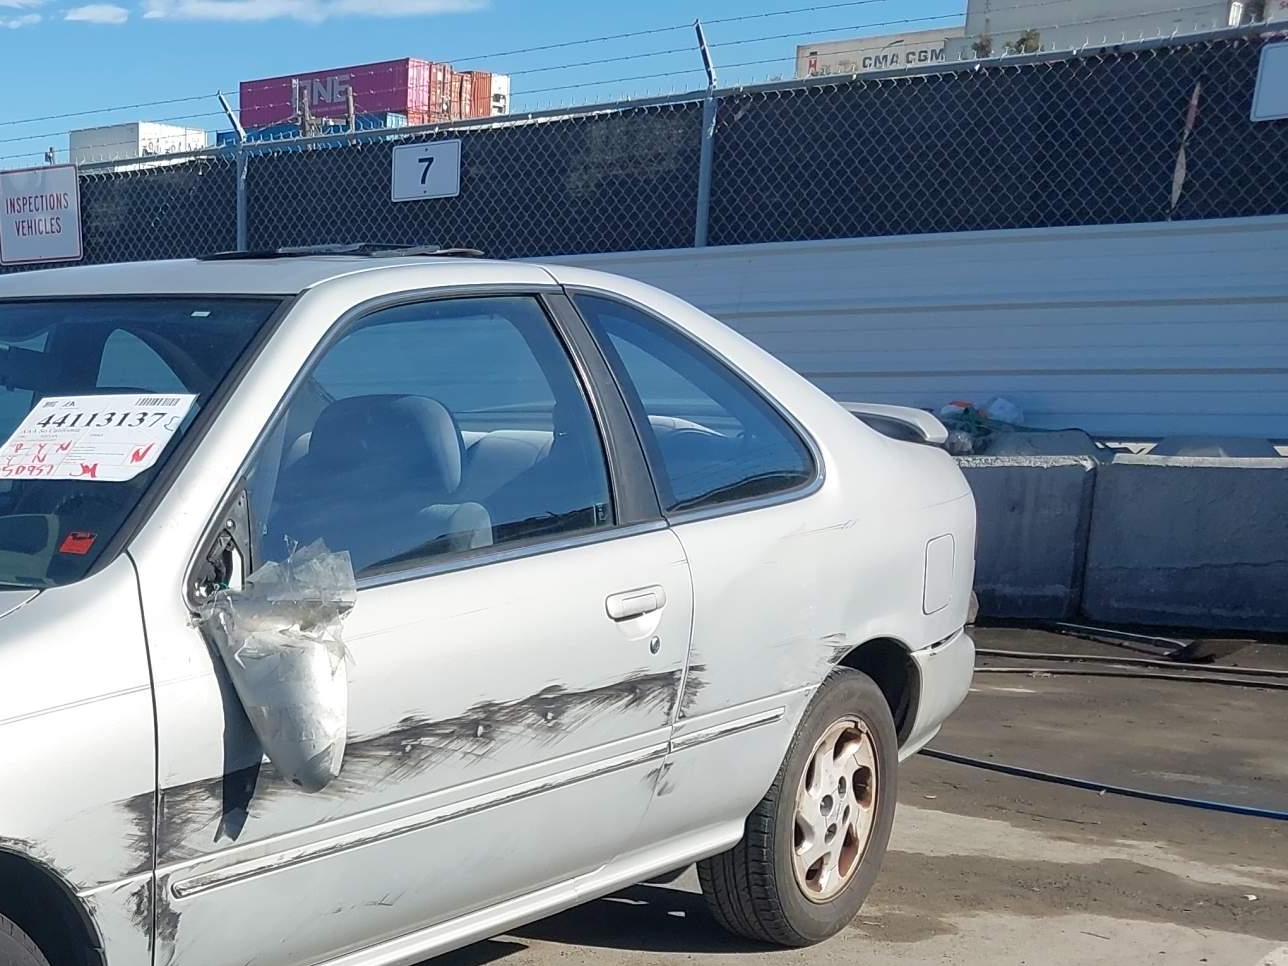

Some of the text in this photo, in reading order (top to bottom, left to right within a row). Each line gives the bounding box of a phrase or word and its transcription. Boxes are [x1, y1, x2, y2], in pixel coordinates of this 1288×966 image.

[862, 52, 900, 69] CMA
[906, 47, 944, 64] CGM
[418, 156, 434, 185] 7
[5, 192, 69, 216] INSPECTIONS
[15, 215, 62, 236] VEHICLES
[37, 411, 167, 428] 44113137
